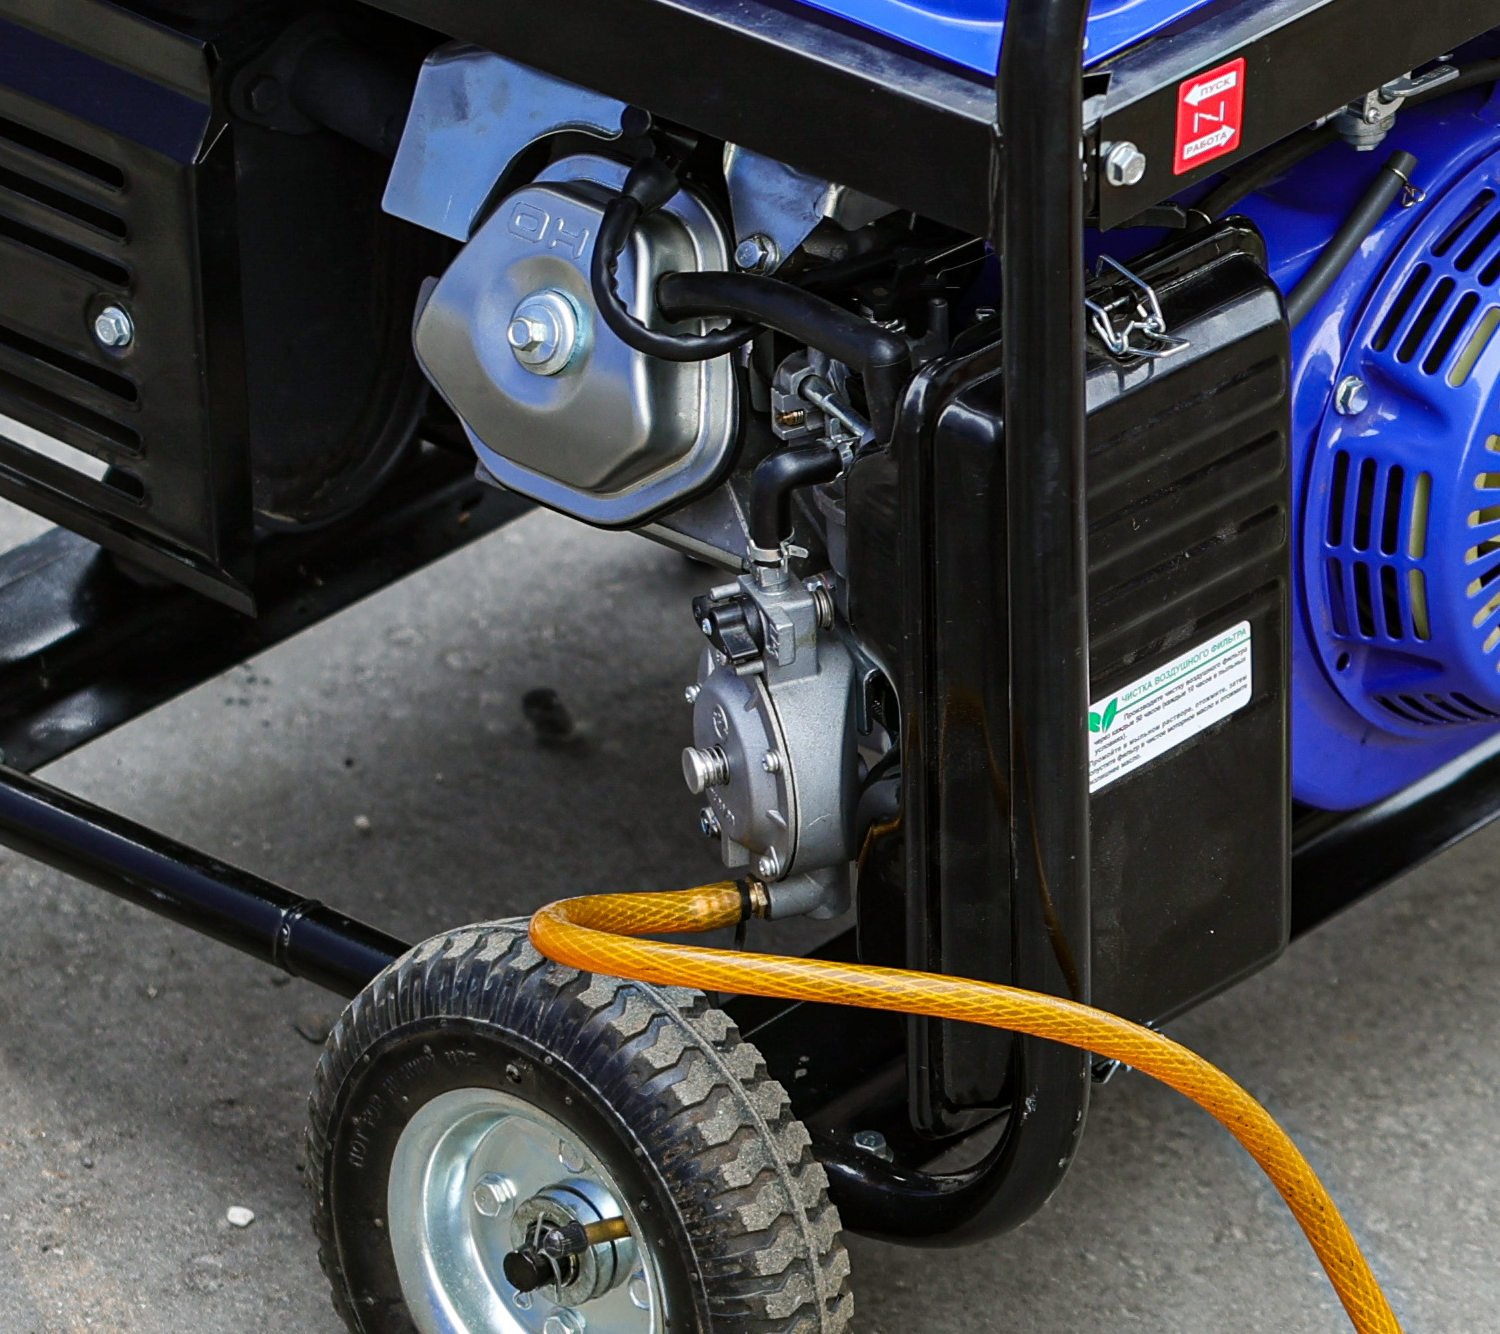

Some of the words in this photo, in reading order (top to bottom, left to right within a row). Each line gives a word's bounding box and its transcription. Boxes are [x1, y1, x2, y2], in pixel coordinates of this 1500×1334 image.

[1200, 76, 1231, 97] ПУСК
[1186, 131, 1228, 155] РАБОТА
[1121, 681, 1153, 701] ЧИСТКА
[1154, 648, 1209, 685] ВОЗДУШНОГО
[1211, 628, 1246, 652] ФИЛЬТРА
